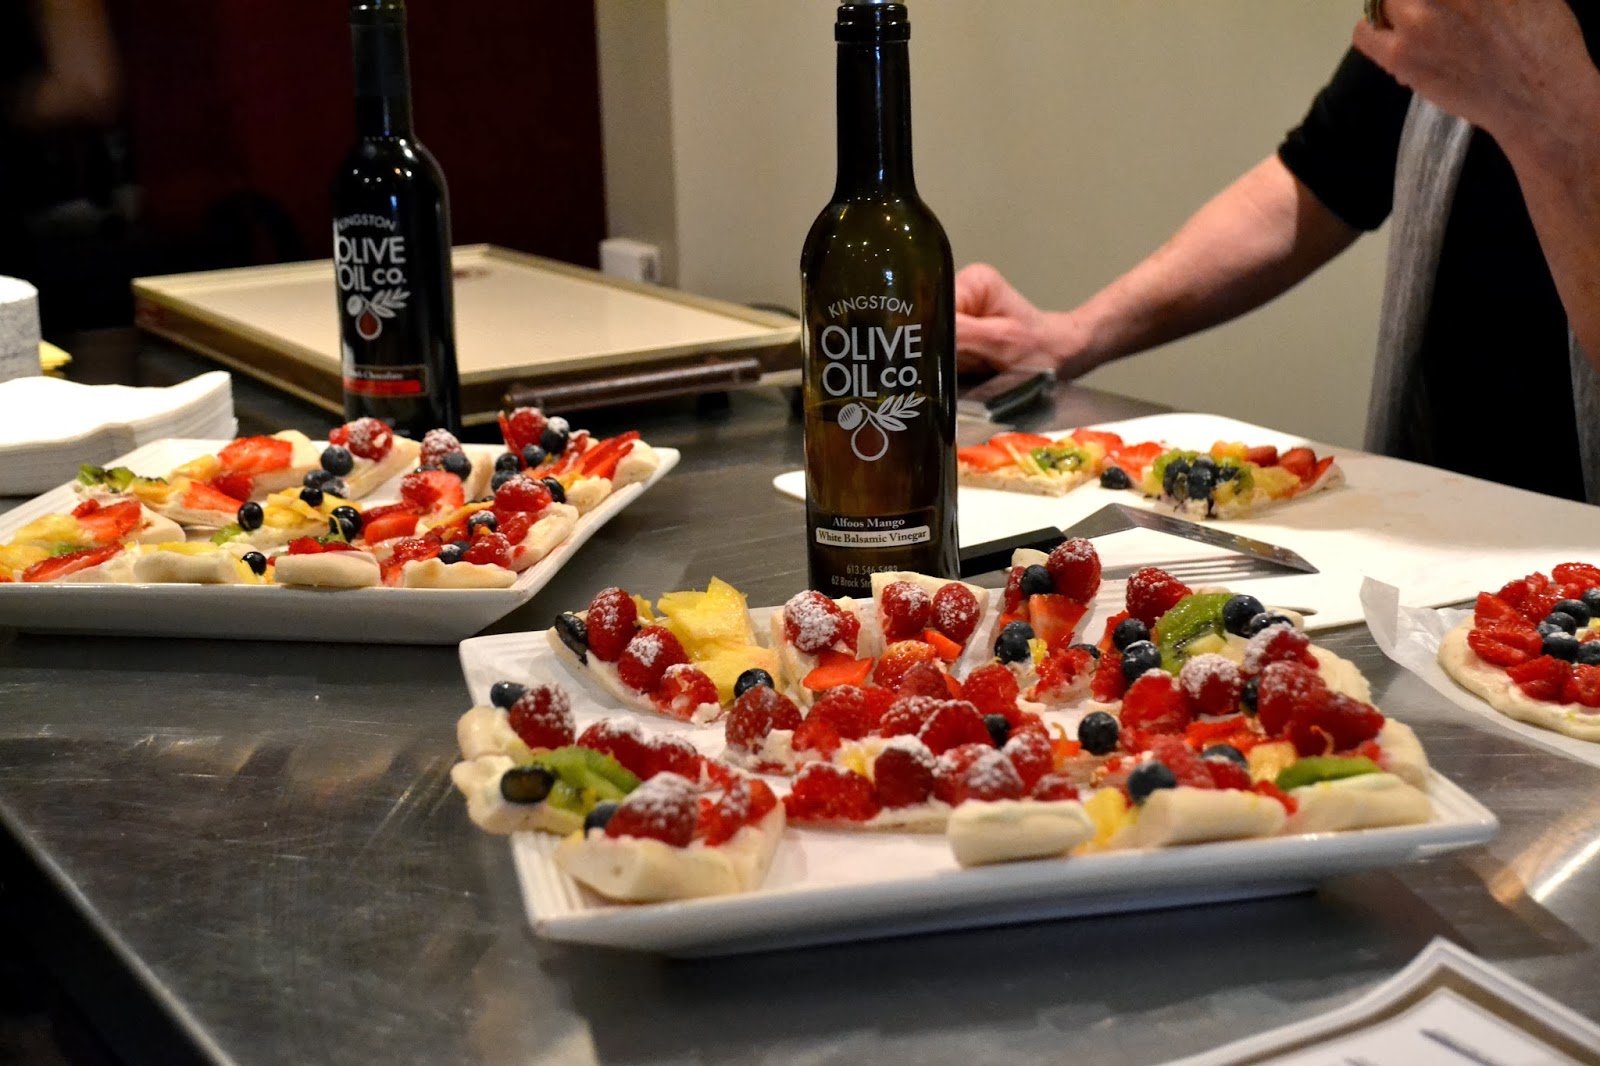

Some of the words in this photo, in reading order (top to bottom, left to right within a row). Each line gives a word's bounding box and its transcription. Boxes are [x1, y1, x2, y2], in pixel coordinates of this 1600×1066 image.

[337, 235, 406, 264] OLIVE
[338, 264, 372, 291] OIL
[828, 295, 914, 318] KINGSTON
[821, 323, 923, 362] OLIVE
[822, 361, 878, 398] OIL
[880, 365, 923, 389] CO.
[832, 517, 865, 528] Alfoos
[867, 517, 906, 529] Mango
[818, 529, 842, 543] White
[843, 533, 888, 544] Balsamic
[889, 530, 927, 542] Vinegar
[840, 576, 859, 588] Brock
